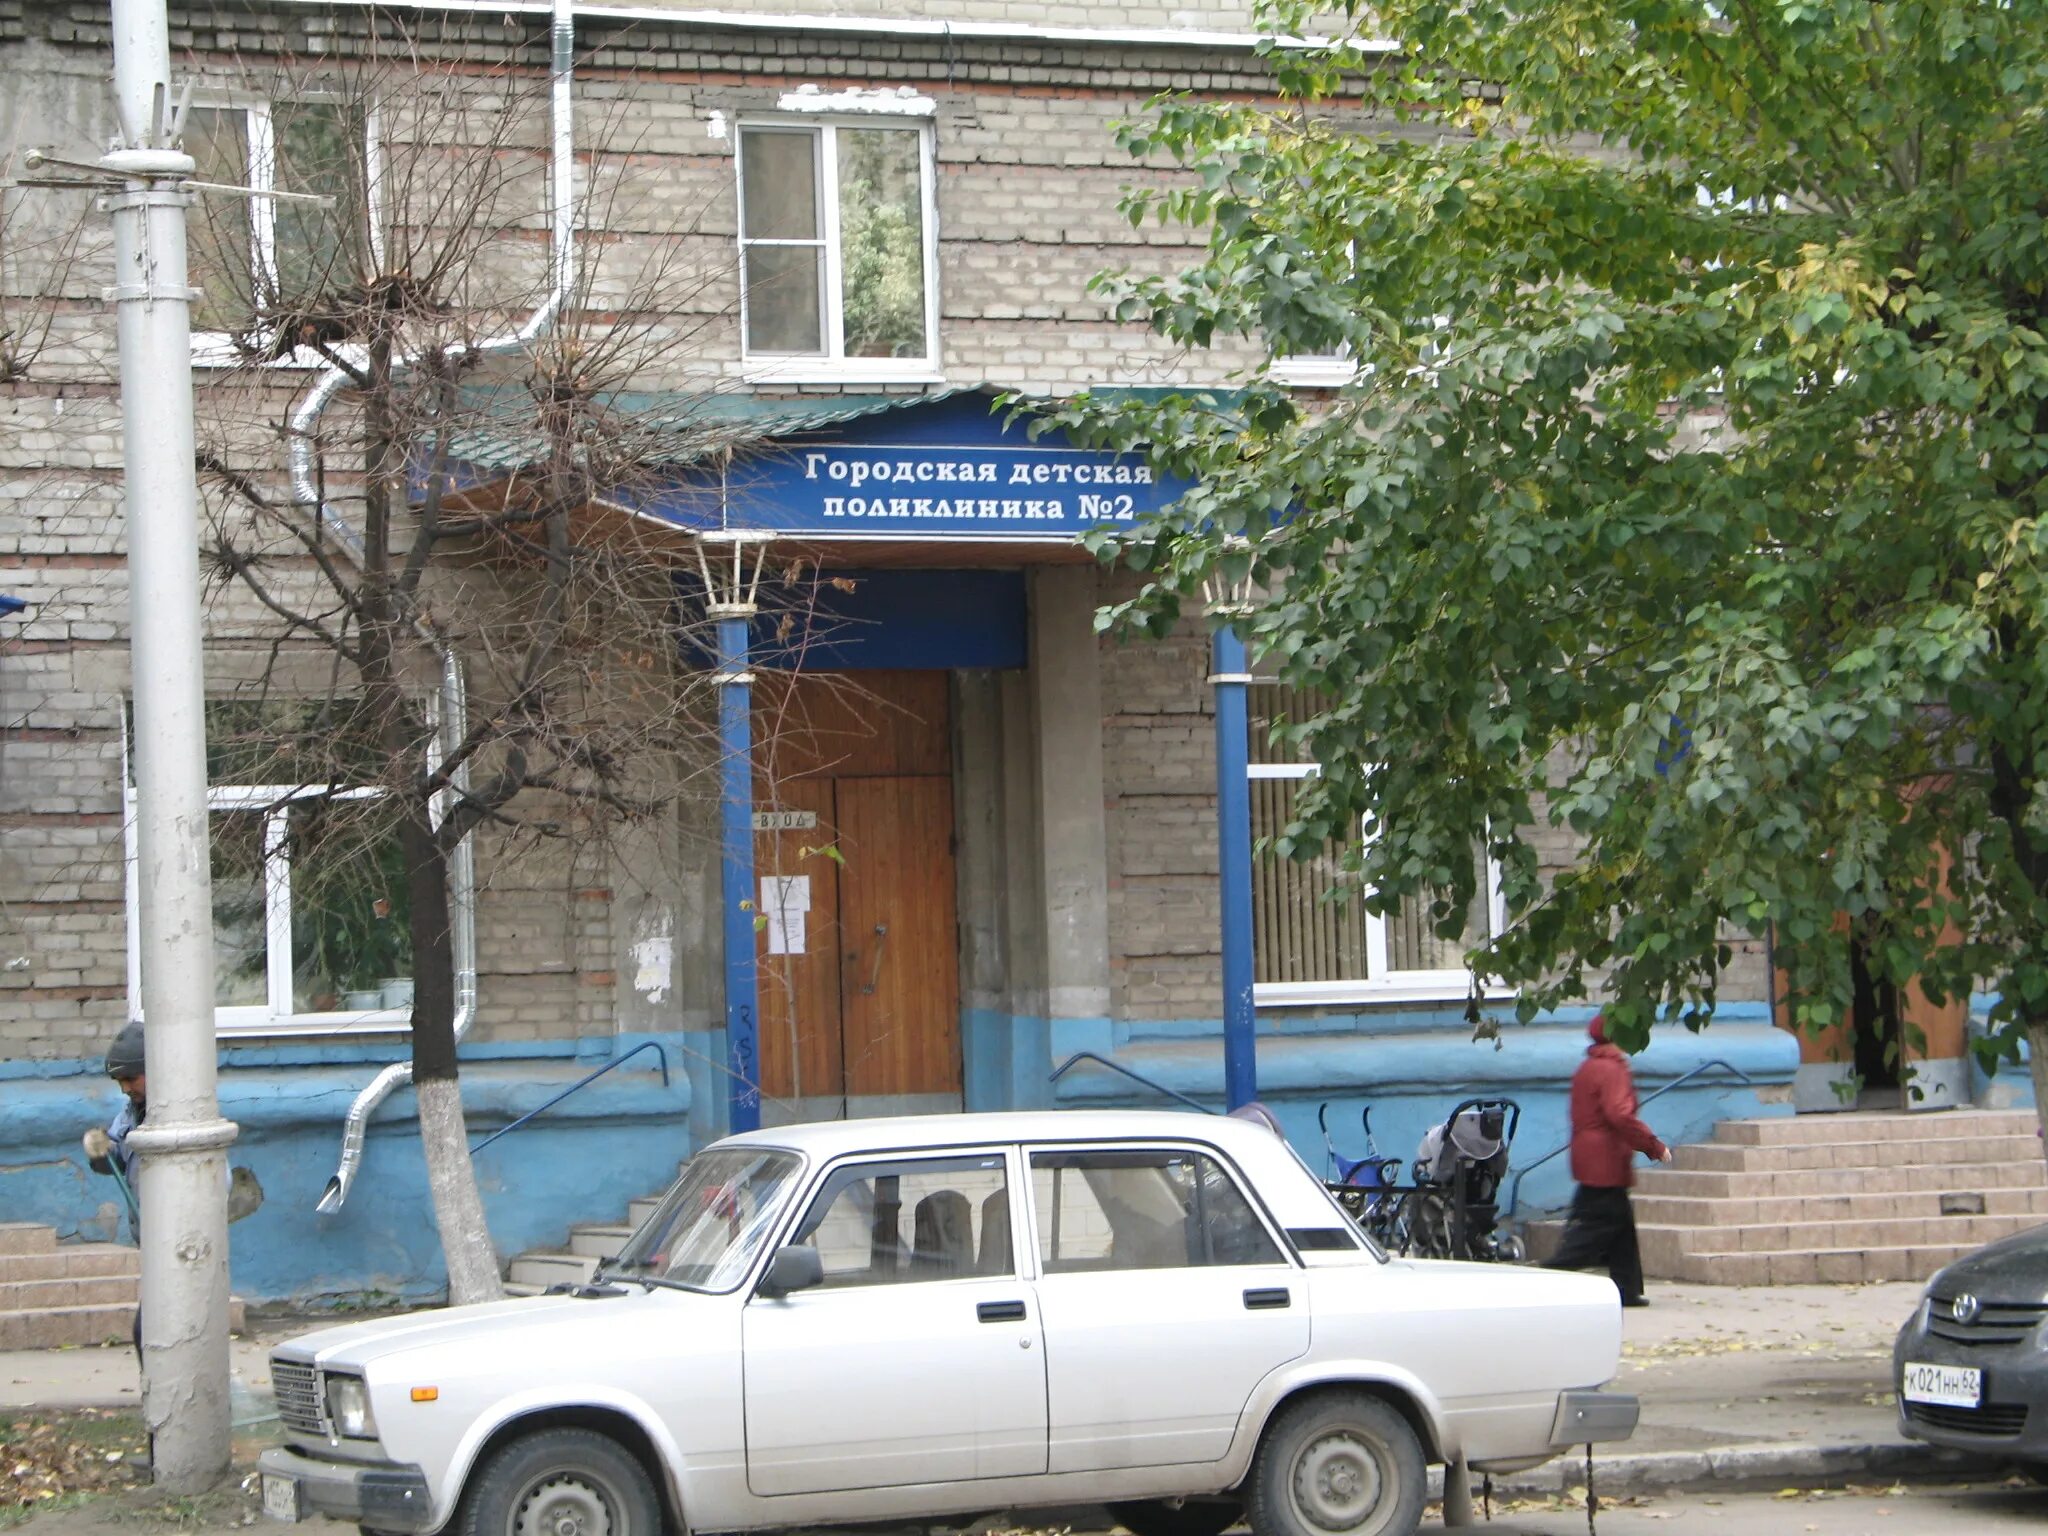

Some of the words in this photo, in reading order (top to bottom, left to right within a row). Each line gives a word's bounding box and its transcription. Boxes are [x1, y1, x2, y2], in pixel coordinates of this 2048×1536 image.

[805, 453, 997, 488] Городская
[1008, 462, 1153, 485] детская
[823, 494, 1064, 519] поликлиника
[1078, 494, 1134, 520] №2
